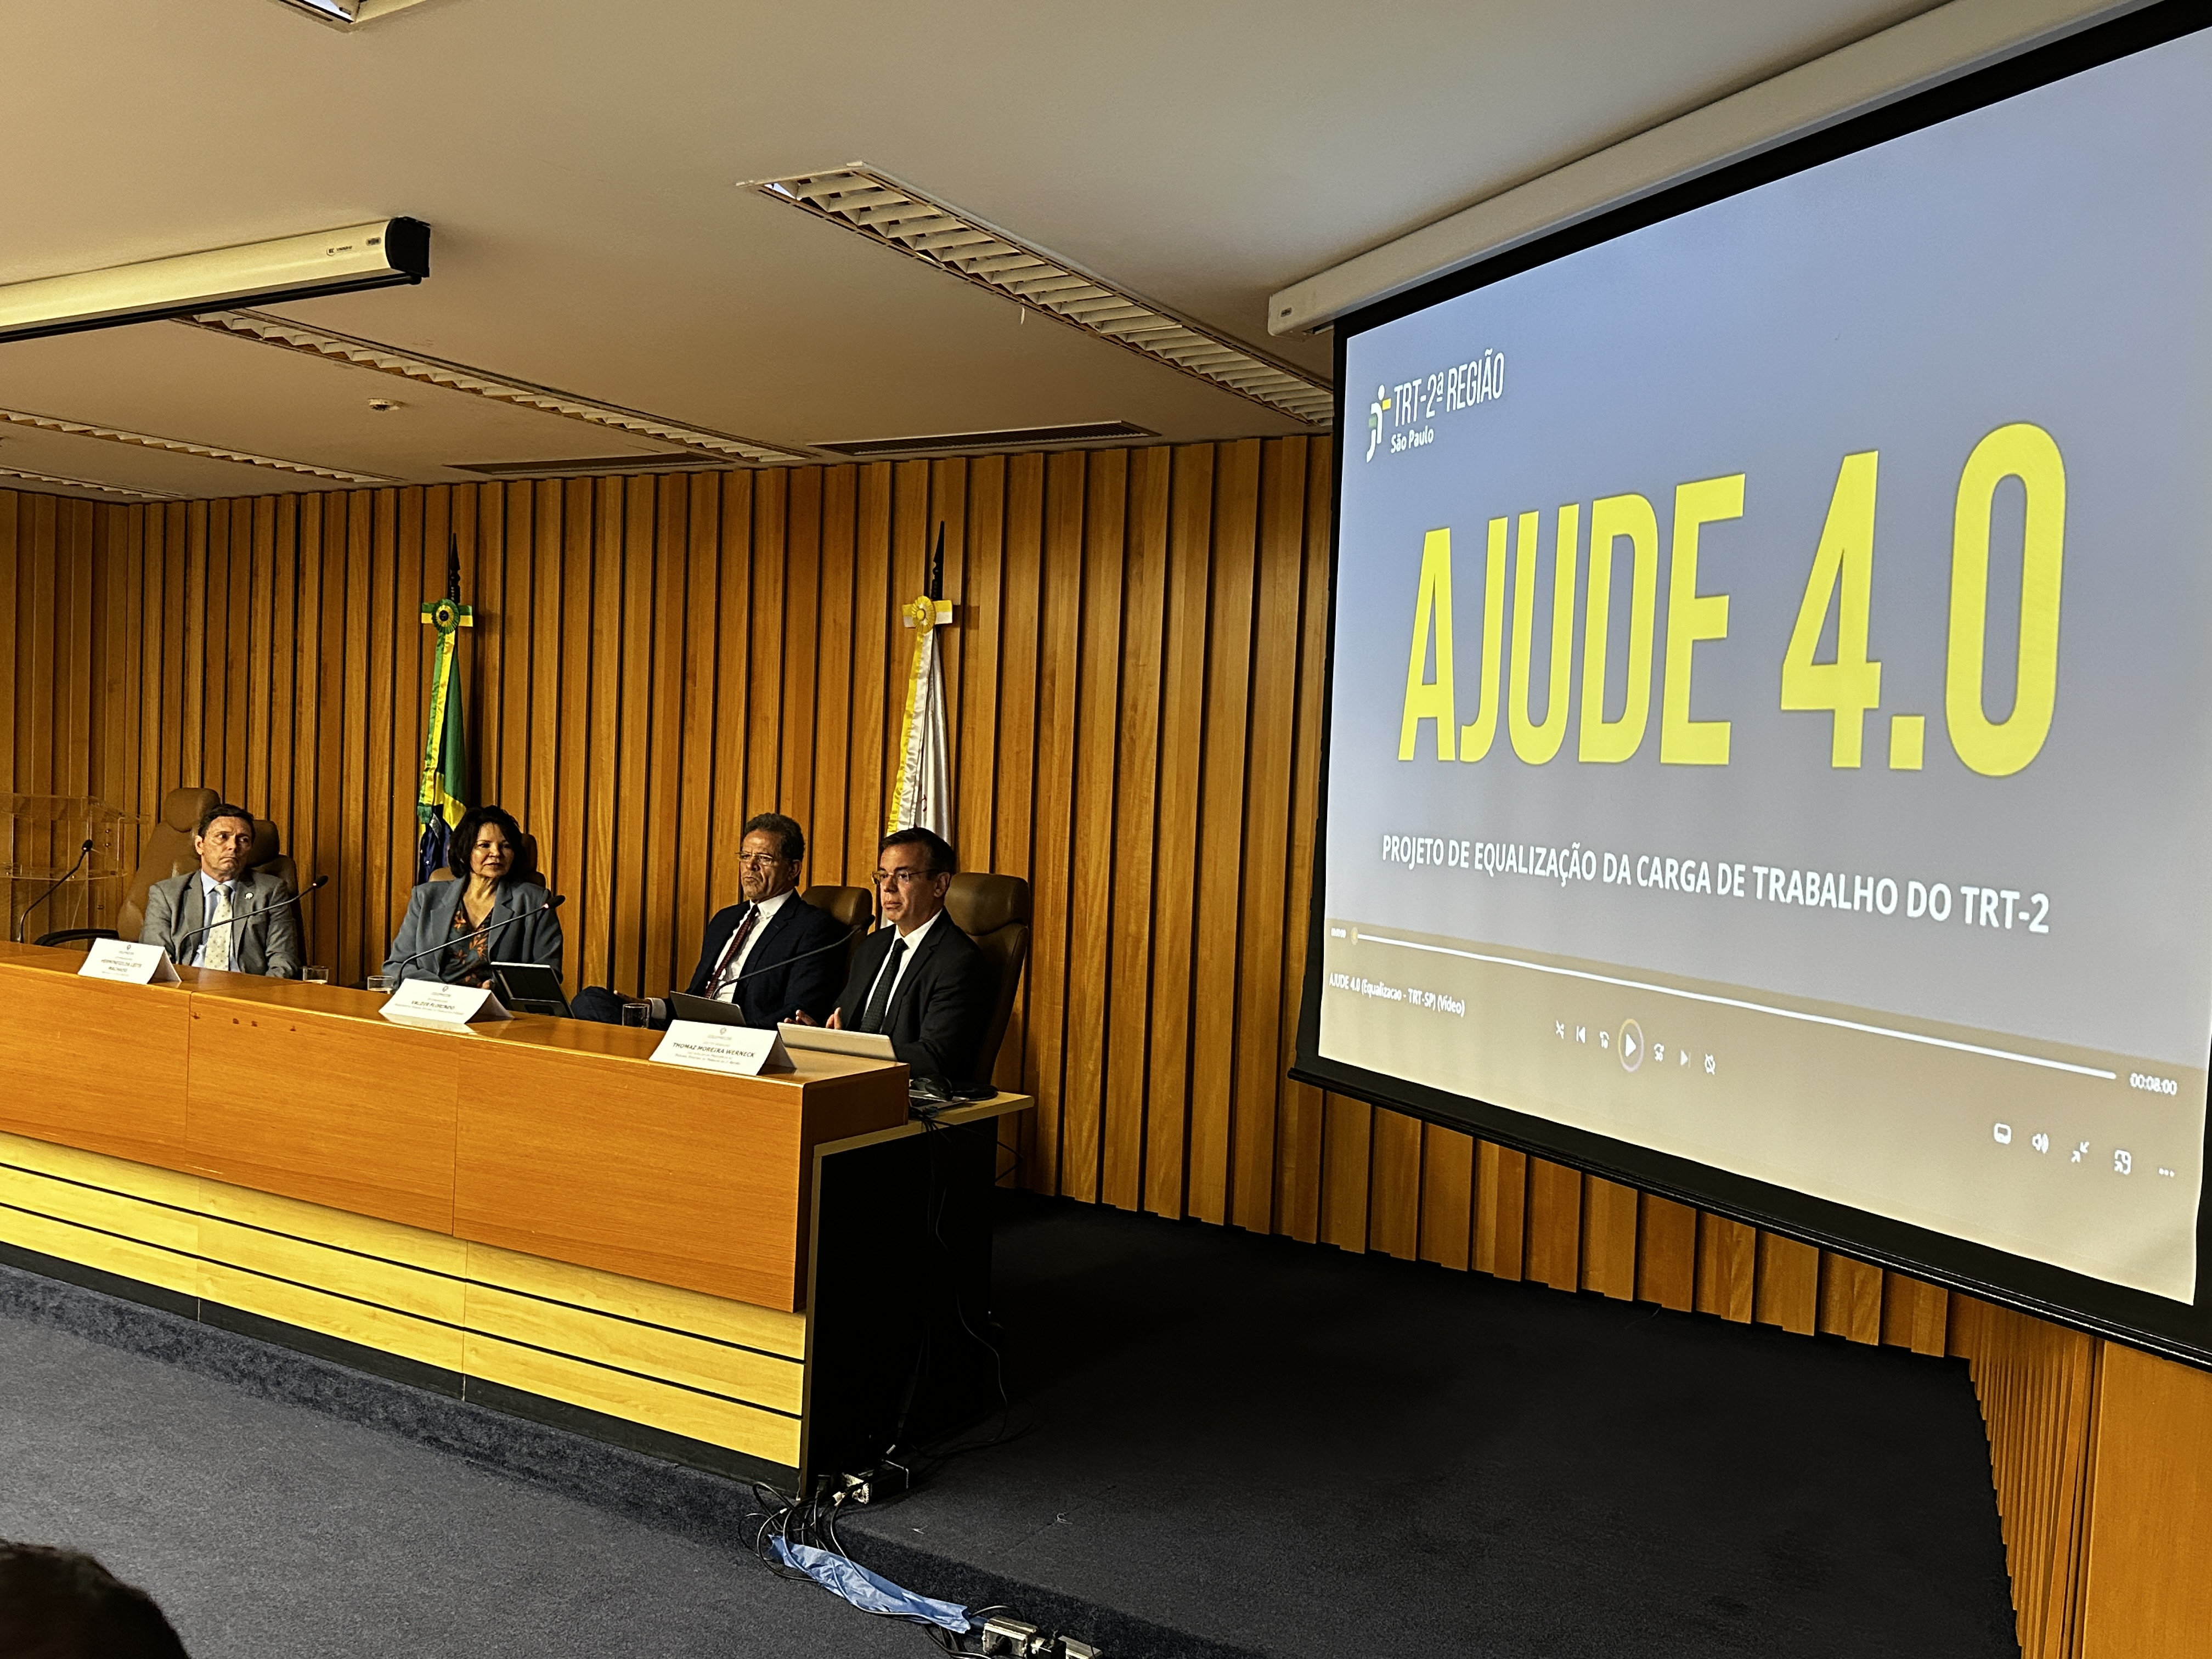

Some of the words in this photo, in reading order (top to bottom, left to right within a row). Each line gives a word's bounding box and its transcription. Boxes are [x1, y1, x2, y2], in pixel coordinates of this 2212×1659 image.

[1394, 372, 1443, 427] TRT-2ª
[1447, 348, 1504, 411] REGIÃO
[1391, 433, 1407, 453] São
[1408, 425, 1434, 448] Paulo
[1398, 473, 1745, 765] AJUDE
[1780, 423, 2066, 777] 4.0
[1383, 835, 1444, 870] PROJETO
[1448, 840, 1470, 868] DE
[1475, 842, 1596, 887] EQUALIZAÇÃO
[1603, 853, 1632, 885] DA
[1637, 855, 1711, 894] CARGA
[1717, 863, 1746, 897] DE
[1752, 866, 1898, 915] TRABALHO
[1907, 881, 1951, 921] DO
[1960, 886, 2049, 933] TRT-2
[1329, 972, 1349, 990] AJUDE
[1350, 977, 1361, 992] 4.0
[1408, 988, 1436, 1011] TRT-SP)
[697, 1046, 724, 1054] MOREIRA
[726, 1049, 755, 1058] WERNECK
[2130, 1073, 2177, 1096] 00:08:00
